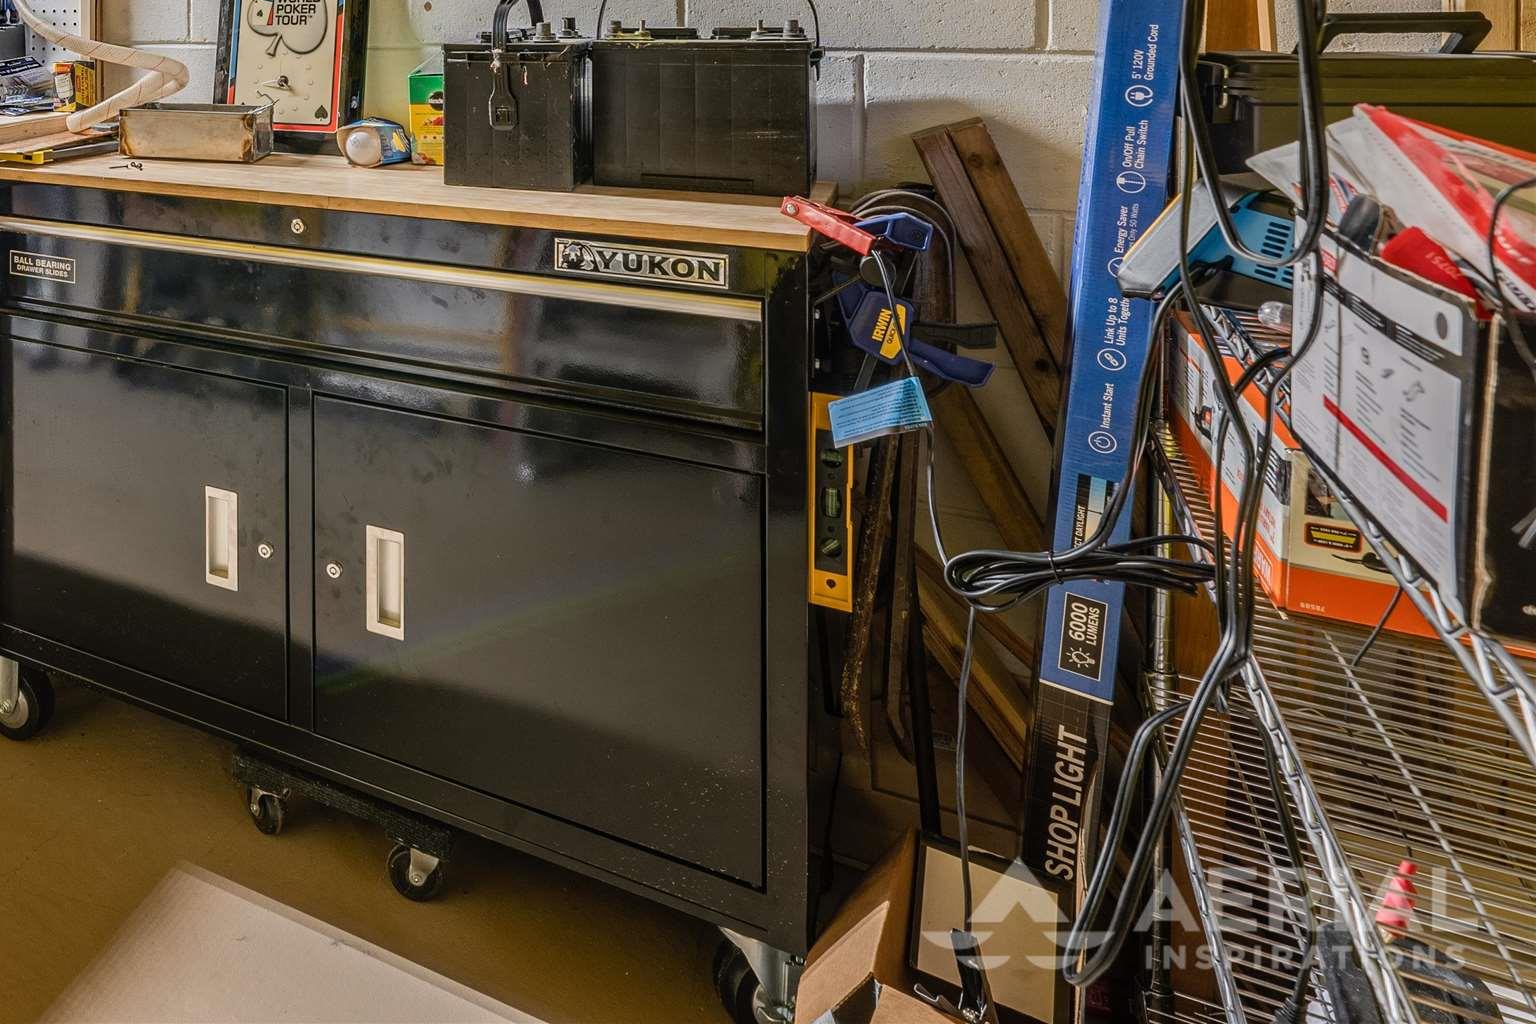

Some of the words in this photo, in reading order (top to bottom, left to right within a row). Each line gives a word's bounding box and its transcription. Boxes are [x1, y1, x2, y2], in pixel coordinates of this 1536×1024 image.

[276, 4, 316, 14] POKER
[1147, 24, 1159, 42] Cord
[1132, 49, 1144, 69] 120V
[1143, 43, 1157, 81] Grounded
[1125, 126, 1135, 142] Pull
[1137, 120, 1149, 145] Switch
[1122, 143, 1134, 168] On/Off
[1135, 147, 1146, 169] Chain
[1116, 205, 1128, 226] Saver
[1130, 219, 1138, 227] 50
[1114, 227, 1128, 254] Energy
[1128, 227, 1138, 241] Only
[13, 256, 33, 266] BALL
[35, 258, 71, 271] BEARING
[16, 264, 44, 274] DRAWER
[44, 268, 68, 278] SLIDES
[595, 250, 721, 282] YUKON
[1107, 304, 1116, 313] to
[1117, 297, 1131, 324] Togeth
[872, 308, 892, 342] IRWIN
[1106, 314, 1118, 325] Up
[1104, 326, 1114, 344] Link
[1116, 326, 1127, 346] Units
[1102, 382, 1115, 403] Start
[1100, 404, 1112, 429] Instant
[1075, 504, 1086, 536] DAYLIGHT
[1068, 601, 1089, 642] 6000
[1084, 606, 1101, 647] LUMENS
[1049, 724, 1087, 806] LIGHT
[1044, 804, 1079, 881] SHOP
